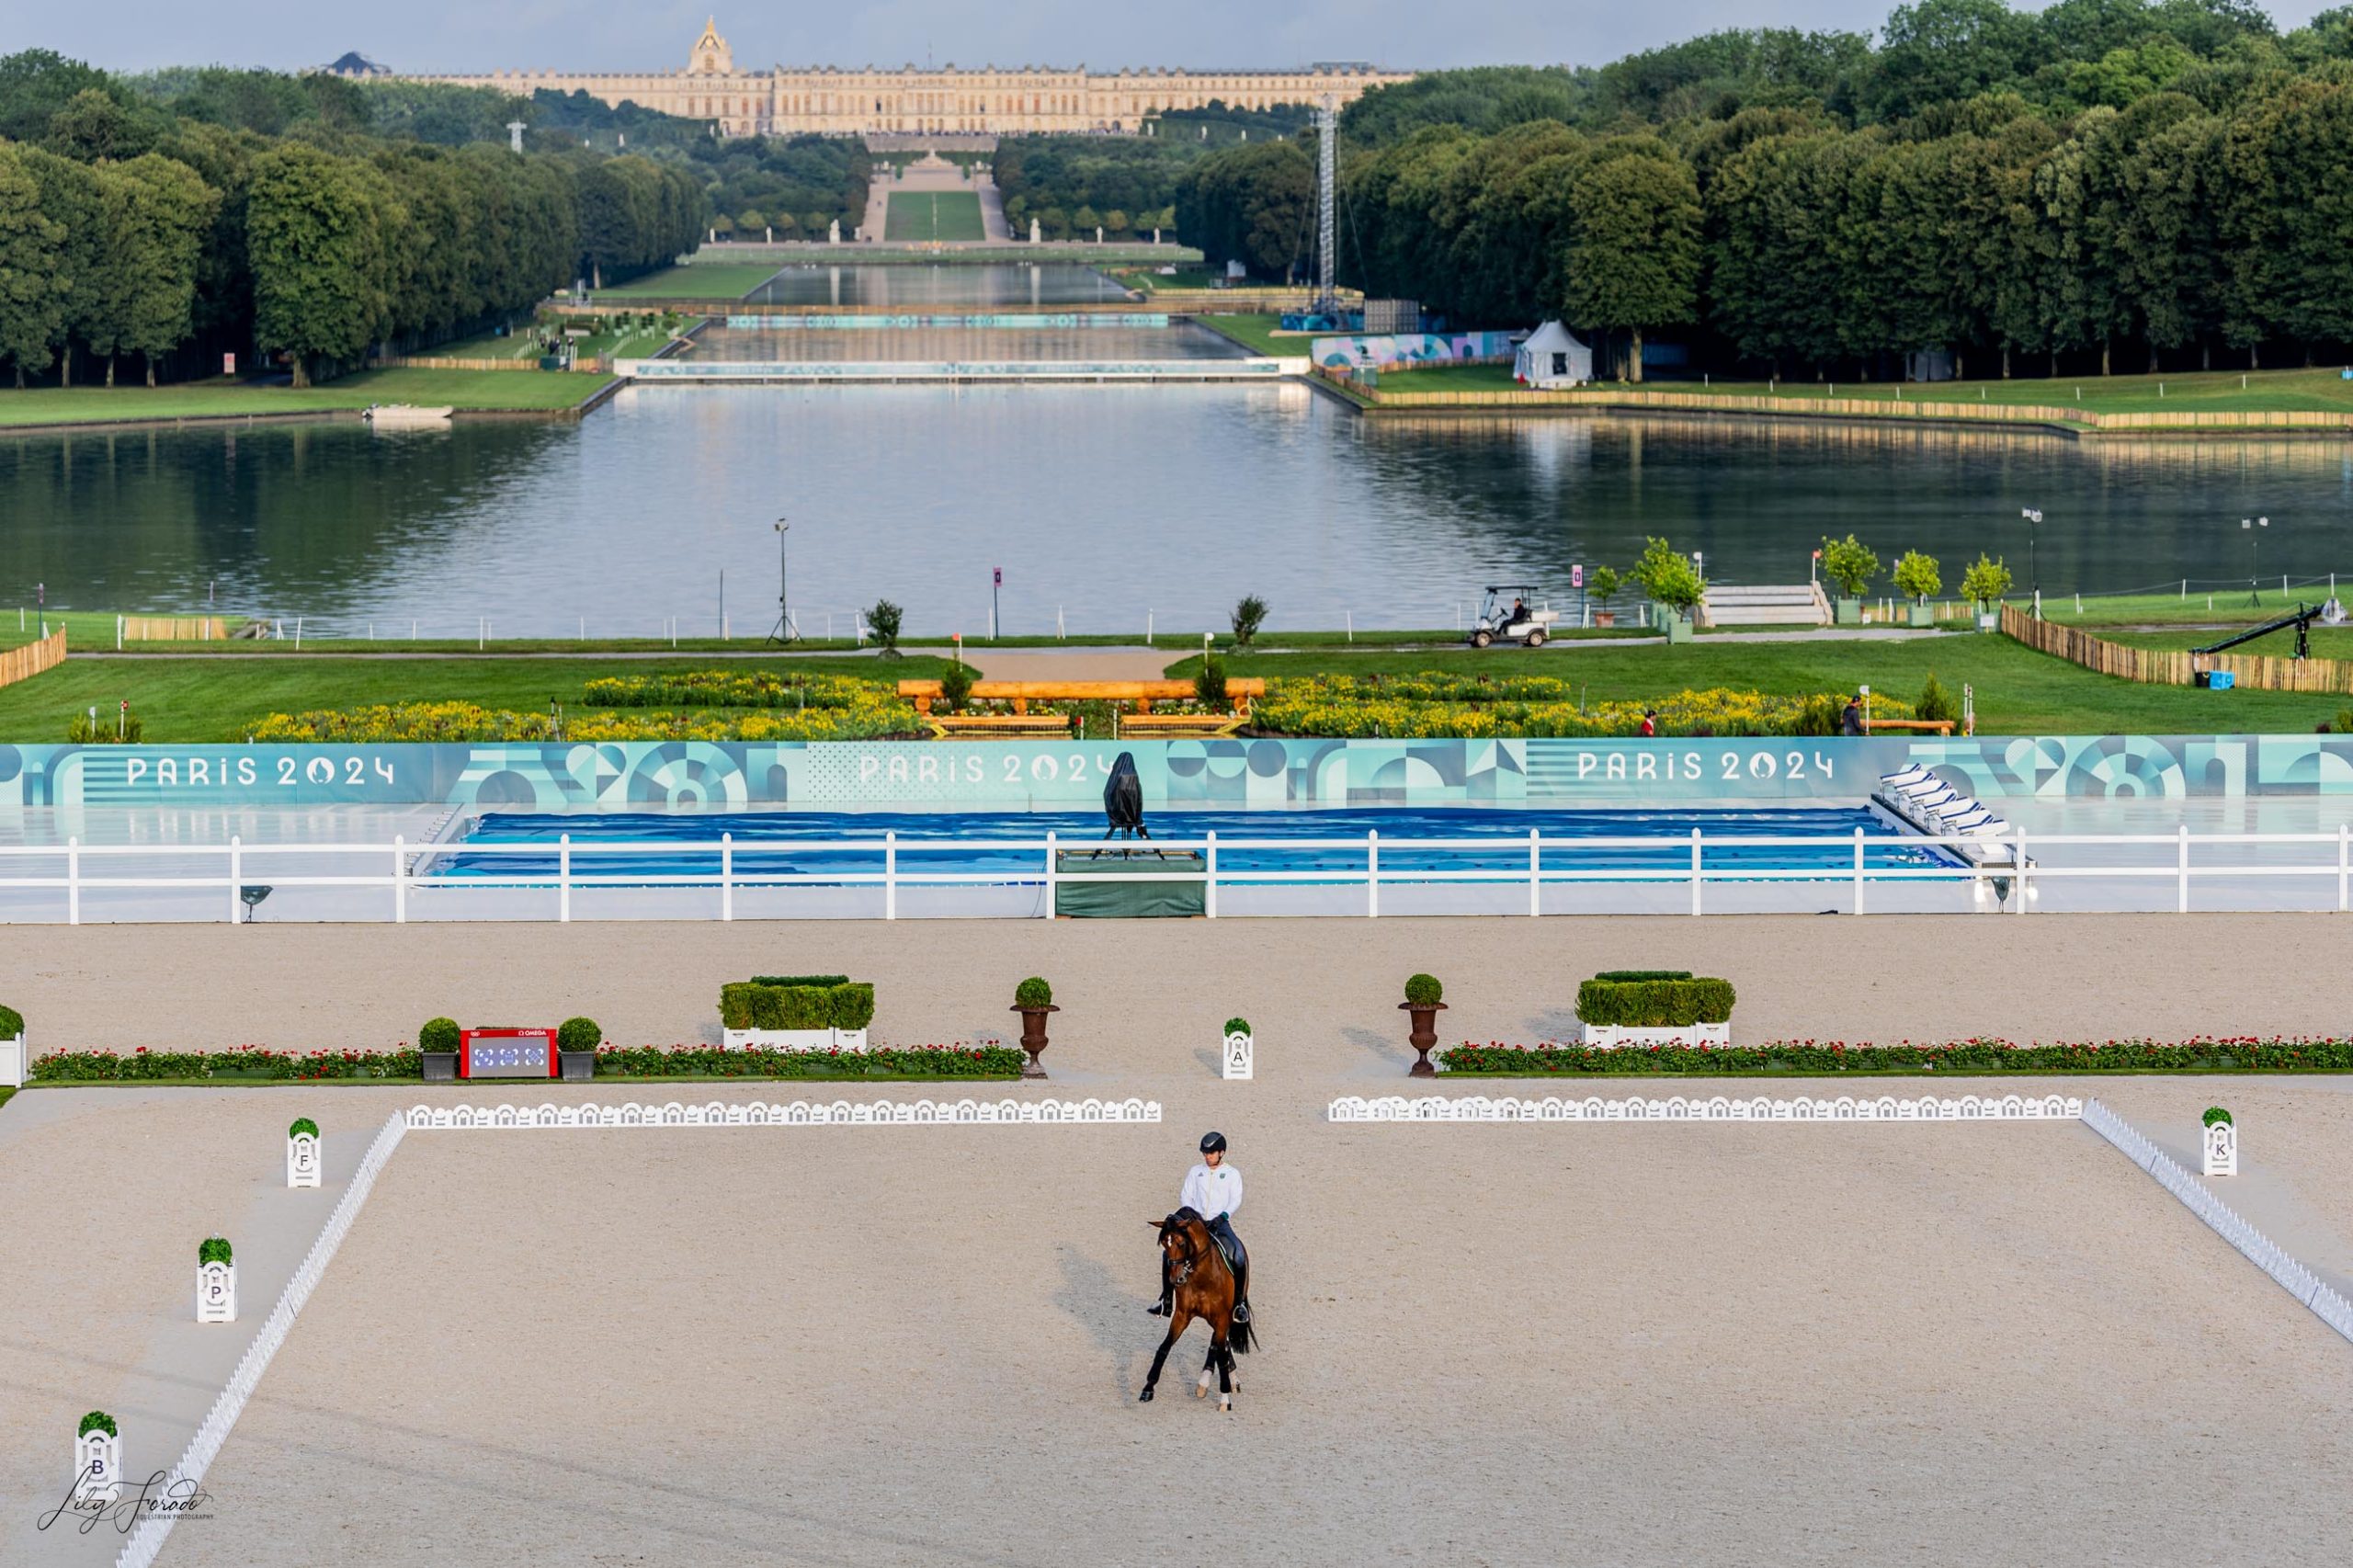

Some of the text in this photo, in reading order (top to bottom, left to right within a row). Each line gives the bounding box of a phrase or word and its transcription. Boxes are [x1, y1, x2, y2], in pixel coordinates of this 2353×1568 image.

[277, 756, 394, 785] 2024
[1721, 751, 1833, 779] 2024
[1233, 1051, 1244, 1062] A
[2216, 1143, 2226, 1155] K
[301, 1154, 309, 1166] F
[210, 1286, 222, 1299] P
[92, 1460, 104, 1474] B
